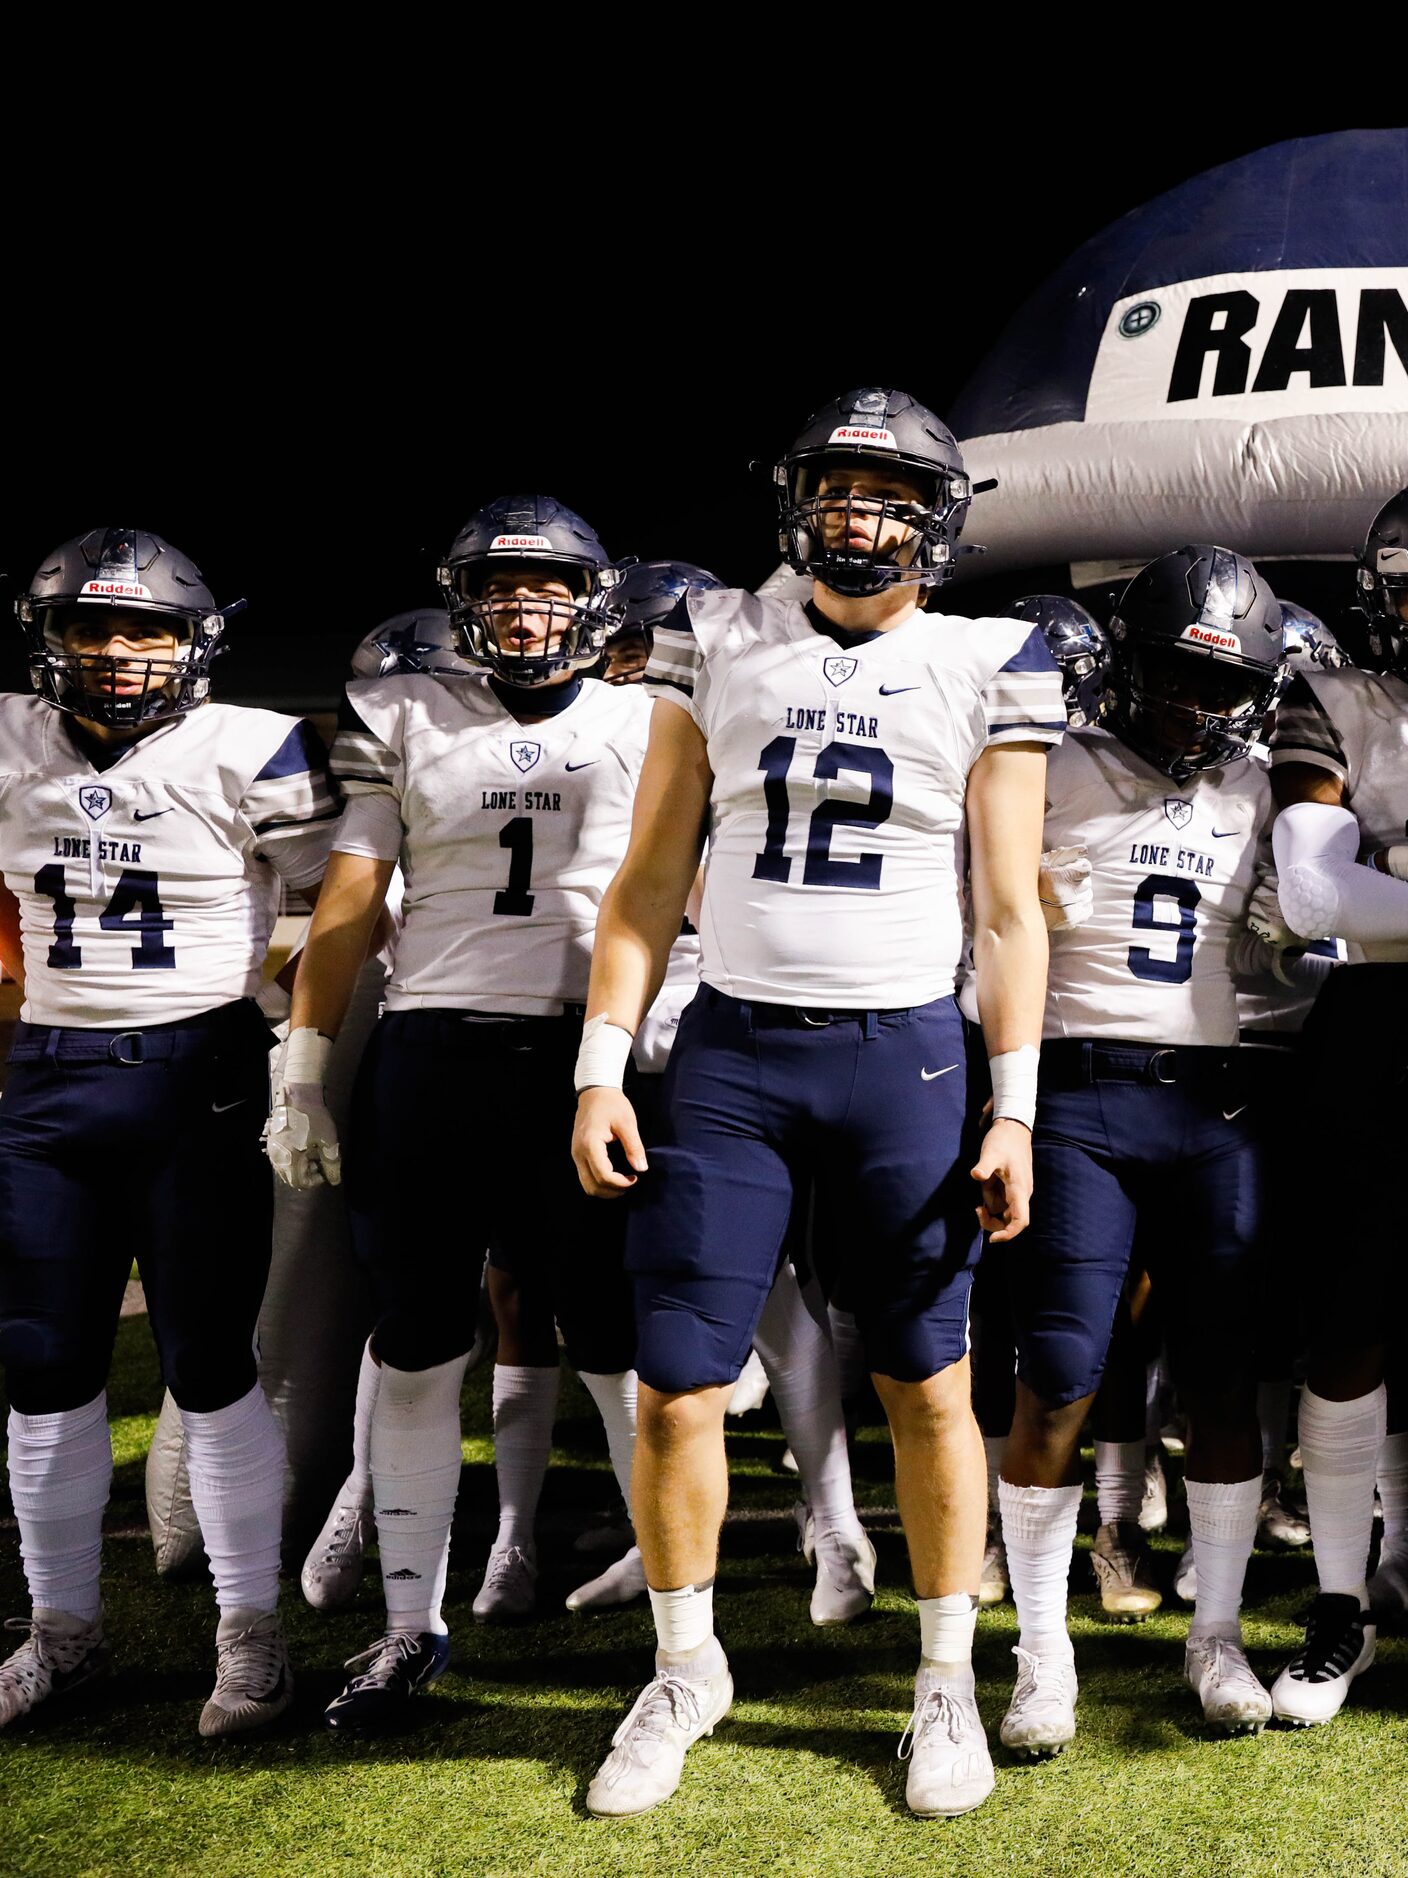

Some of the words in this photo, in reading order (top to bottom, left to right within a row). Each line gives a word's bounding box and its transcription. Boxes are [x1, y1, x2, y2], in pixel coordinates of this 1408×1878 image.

[836, 427, 888, 441] Riddell
[497, 536, 545, 548] Riddell
[89, 581, 144, 596] Riddell
[1188, 627, 1237, 649] Riddell
[785, 707, 827, 732] LONE
[836, 711, 879, 738] STAR
[481, 791, 516, 811] LONE
[525, 791, 562, 811] STAR
[751, 735, 895, 890] 12
[54, 836, 91, 859] LONE
[97, 839, 142, 863] STAR
[1129, 844, 1170, 867] LONE
[1176, 850, 1215, 877] STAR
[493, 817, 536, 917] 1
[34, 863, 176, 969] 14
[1127, 873, 1202, 985] 9
